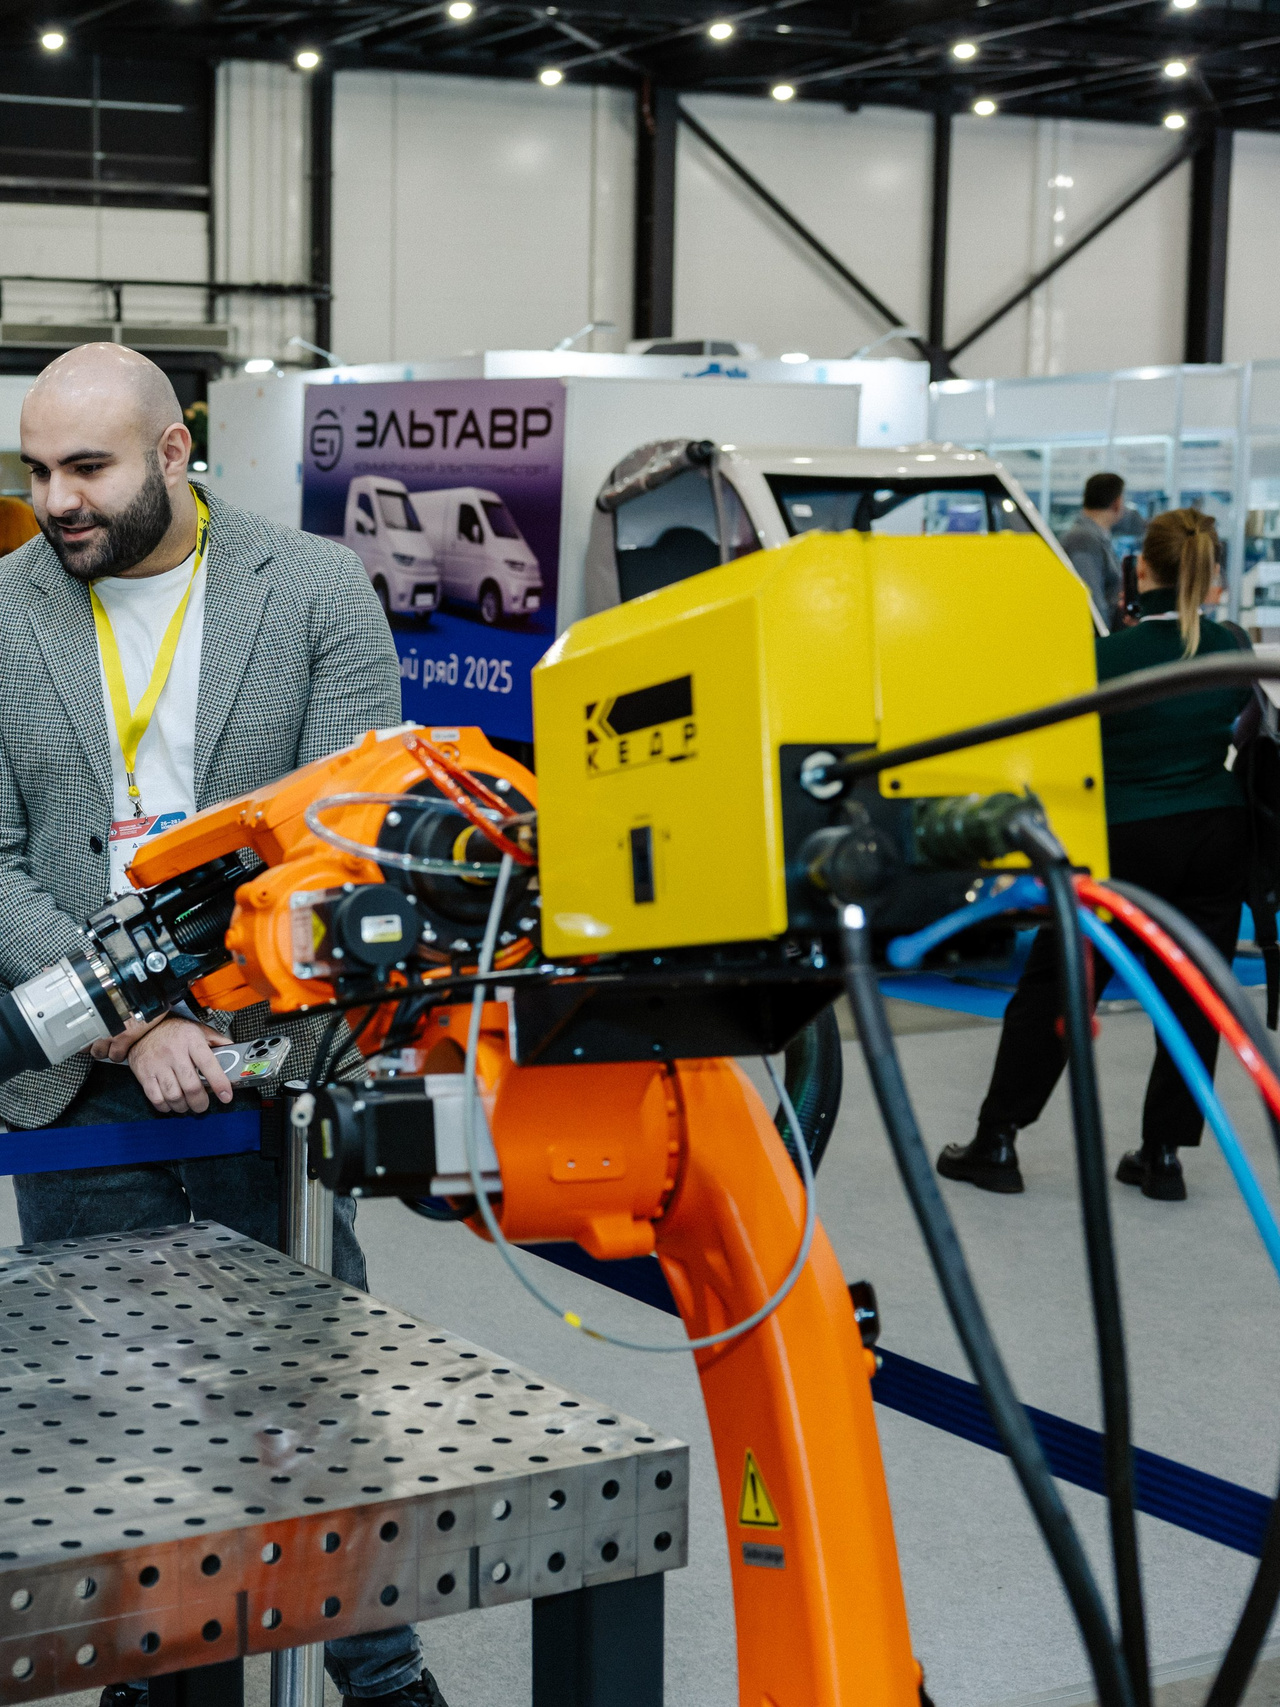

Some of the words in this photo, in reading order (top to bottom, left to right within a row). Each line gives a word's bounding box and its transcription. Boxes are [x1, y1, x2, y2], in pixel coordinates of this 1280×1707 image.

[355, 407, 553, 450] ЭЛЬТАВР
[423, 653, 459, 690] ряд
[464, 656, 513, 694] 2025
